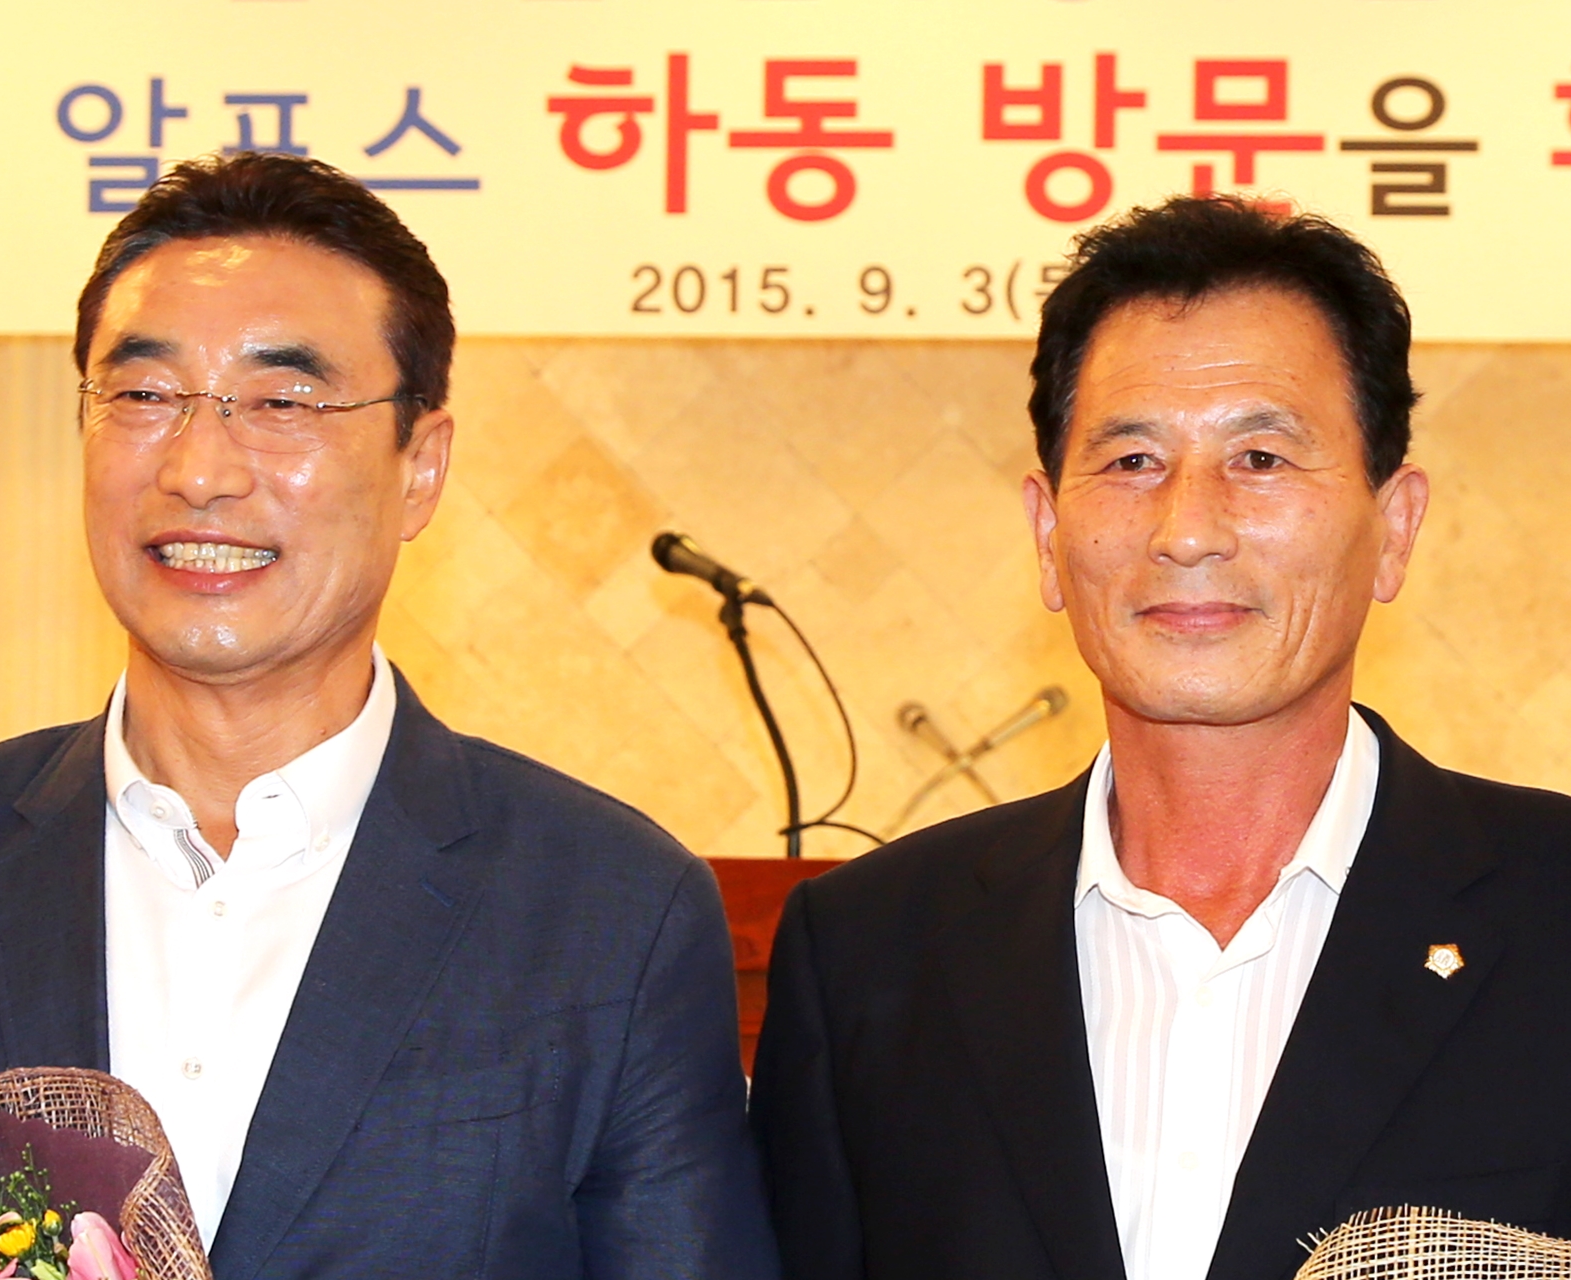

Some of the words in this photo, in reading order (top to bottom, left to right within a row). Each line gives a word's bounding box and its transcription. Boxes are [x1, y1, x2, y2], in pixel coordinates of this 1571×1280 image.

[55, 77, 482, 213] 알프스
[546, 51, 895, 224] 하동
[981, 52, 1480, 224] 방문을
[630, 264, 815, 317] 2015.
[858, 265, 916, 318] 9.
